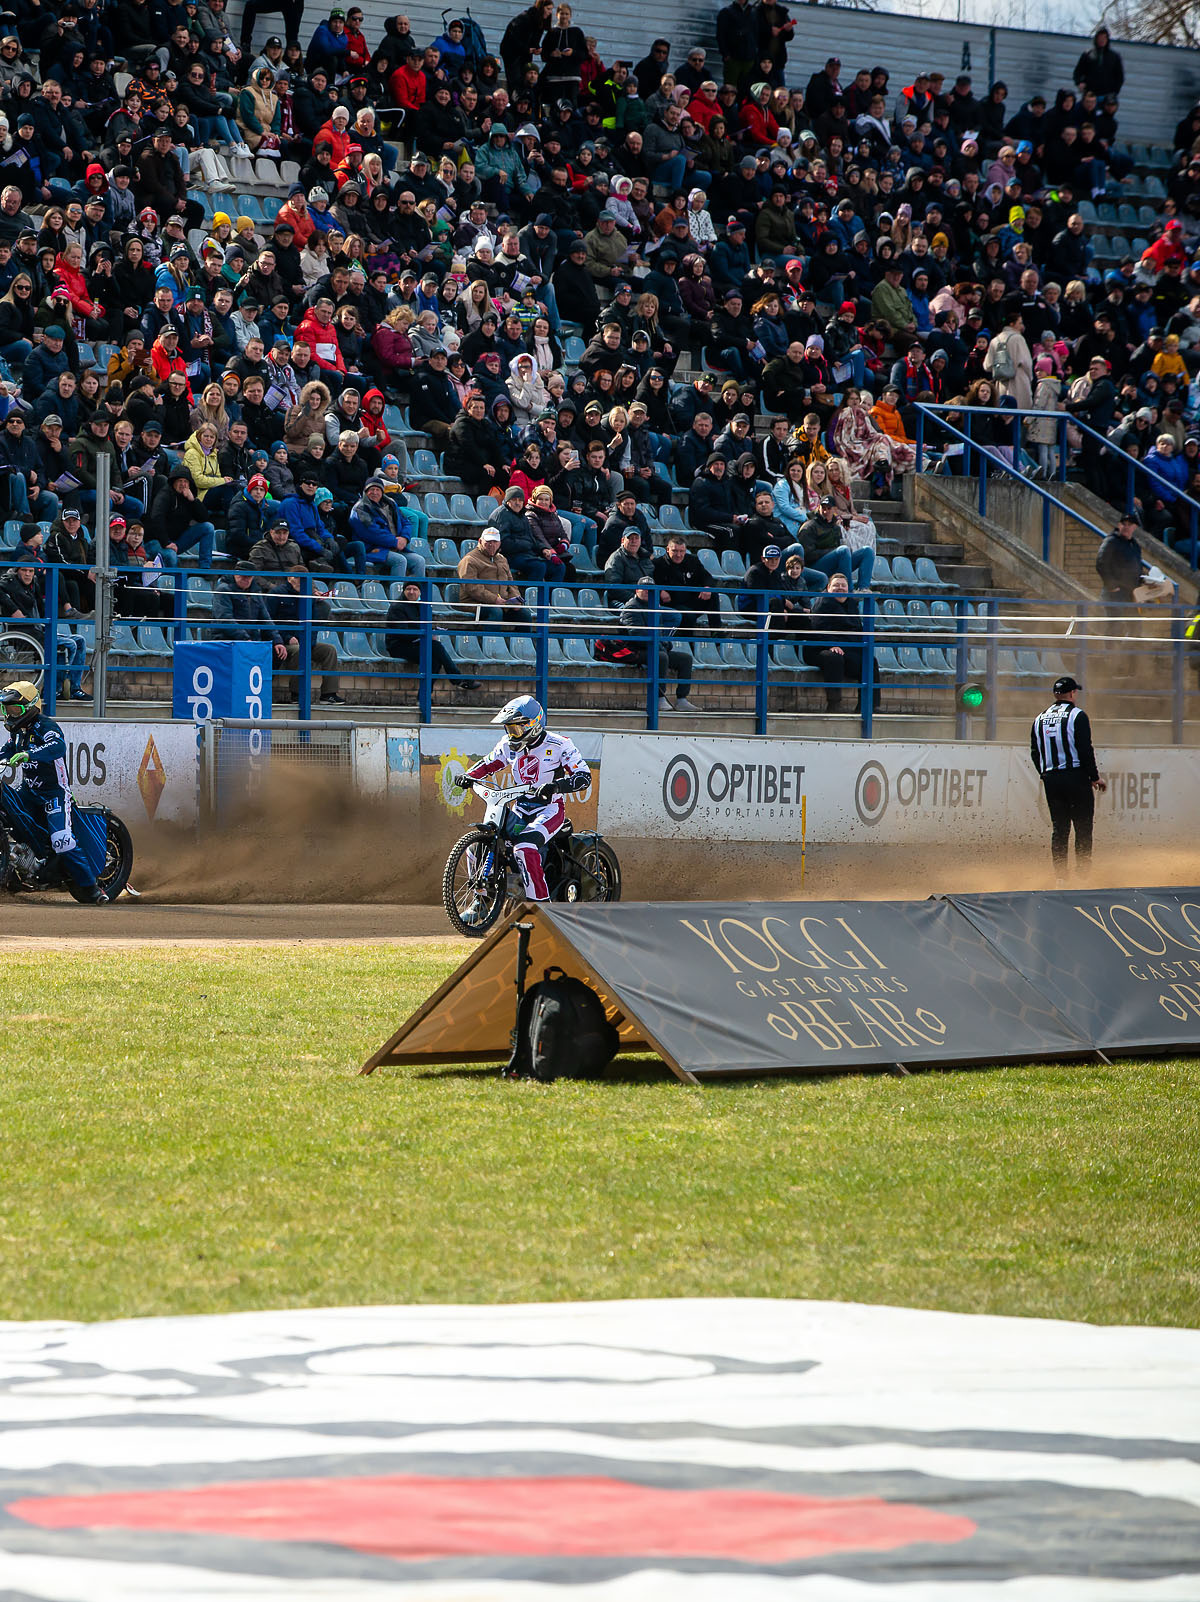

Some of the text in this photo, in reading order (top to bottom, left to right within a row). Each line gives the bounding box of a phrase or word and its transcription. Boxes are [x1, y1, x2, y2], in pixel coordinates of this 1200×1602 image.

[707, 762, 805, 805] OPTIBET
[897, 767, 988, 807] OPTIBET
[1096, 772, 1161, 810] PTIBET
[680, 916, 888, 974] YOGGI
[779, 998, 945, 1051] BEAR
